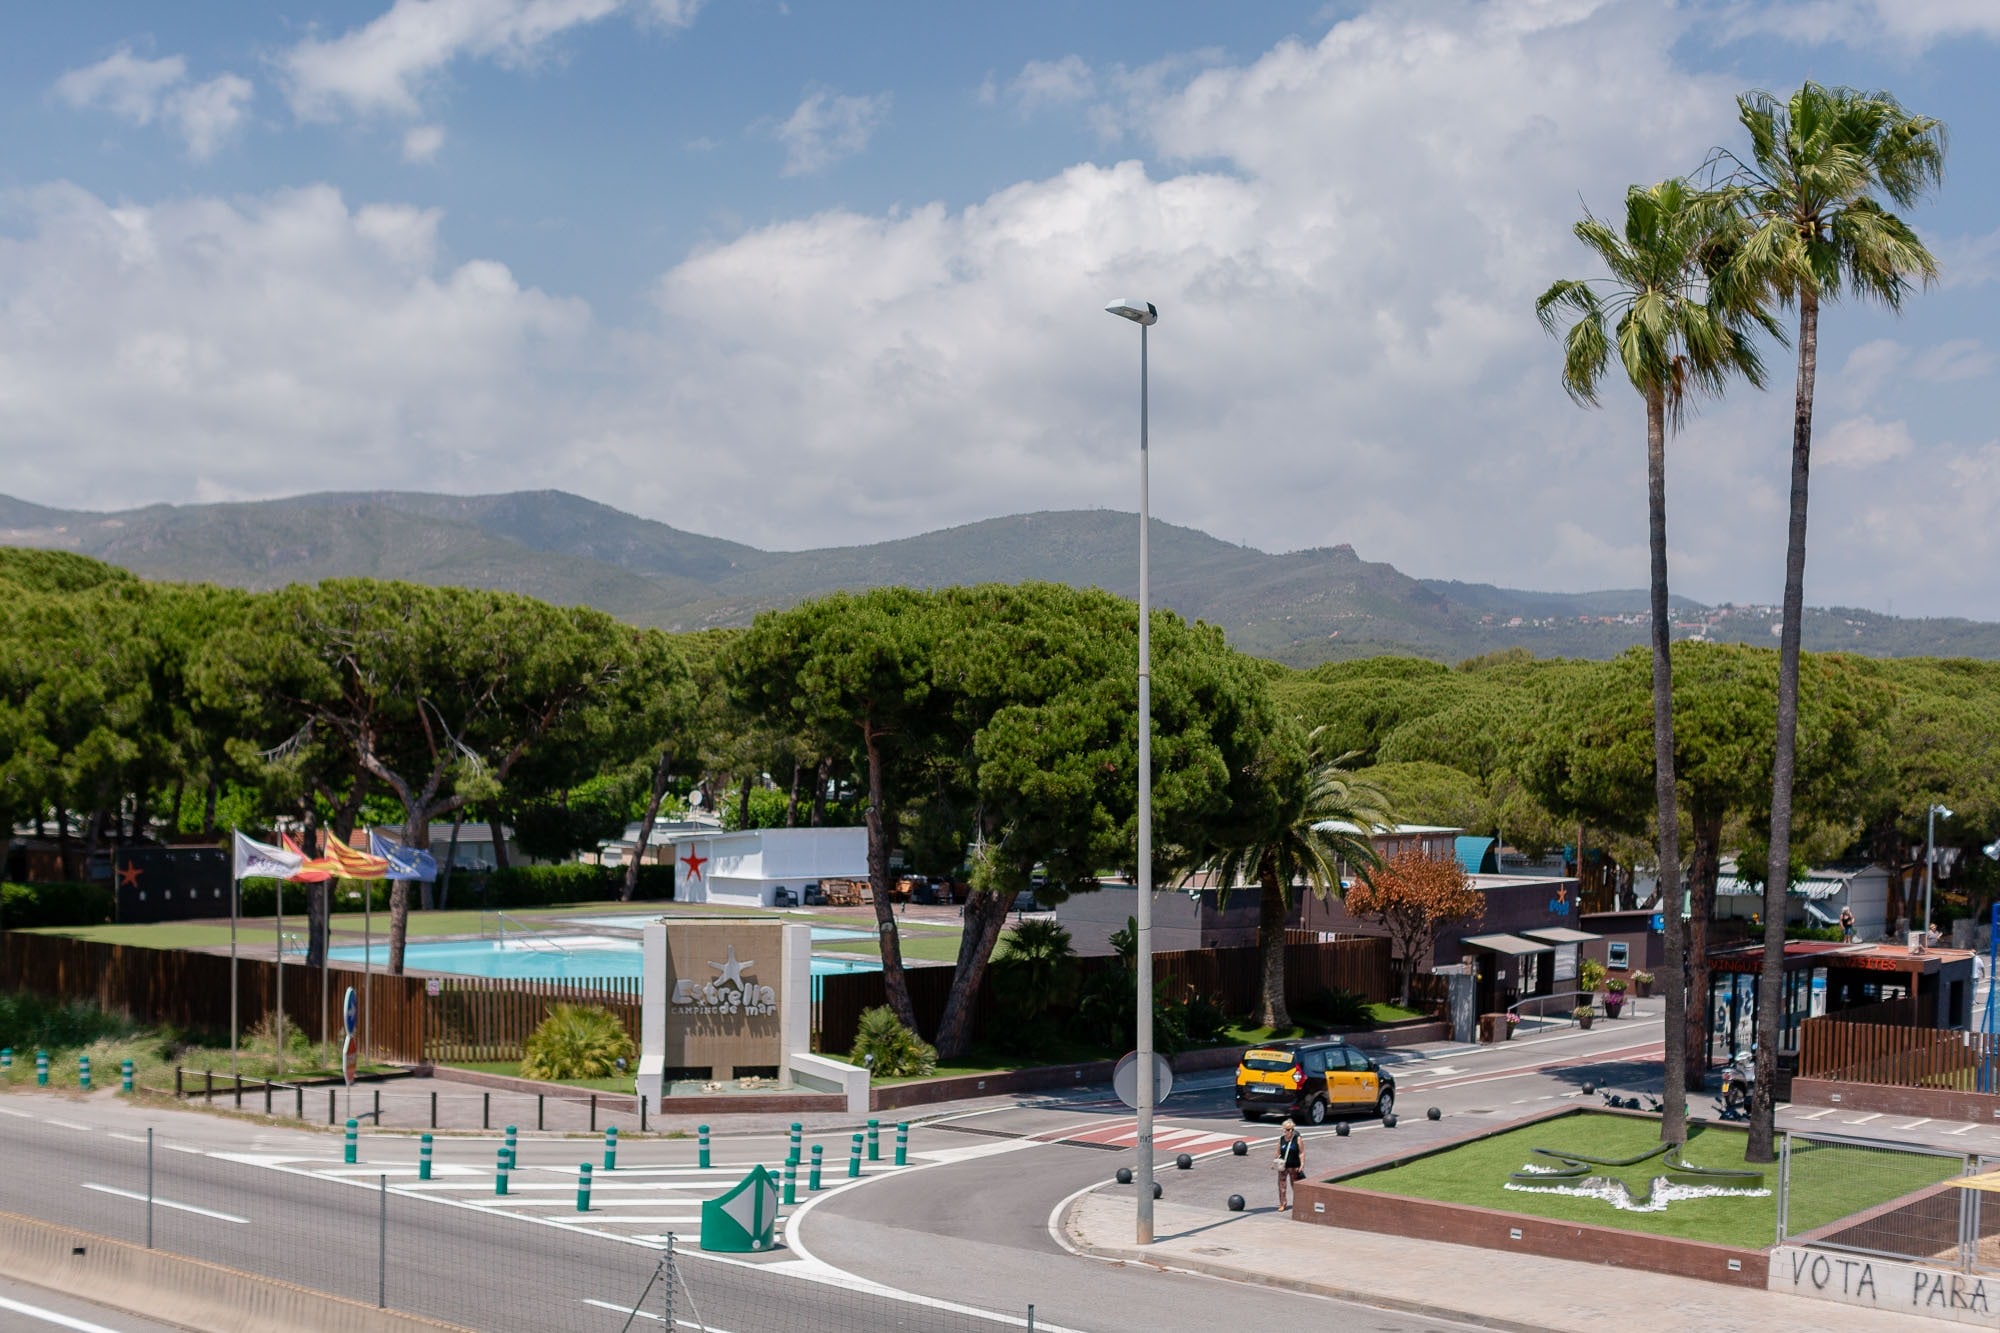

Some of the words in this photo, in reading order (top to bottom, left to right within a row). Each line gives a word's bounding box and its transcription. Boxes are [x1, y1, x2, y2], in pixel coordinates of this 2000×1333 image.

[671, 979, 775, 1005] Estrella
[671, 1006, 718, 1015] CAMPING
[719, 1001, 737, 1015] de
[744, 1002, 776, 1017] mar
[1792, 1251, 1877, 1300] VOTA
[1912, 1271, 1989, 1313] PARA
